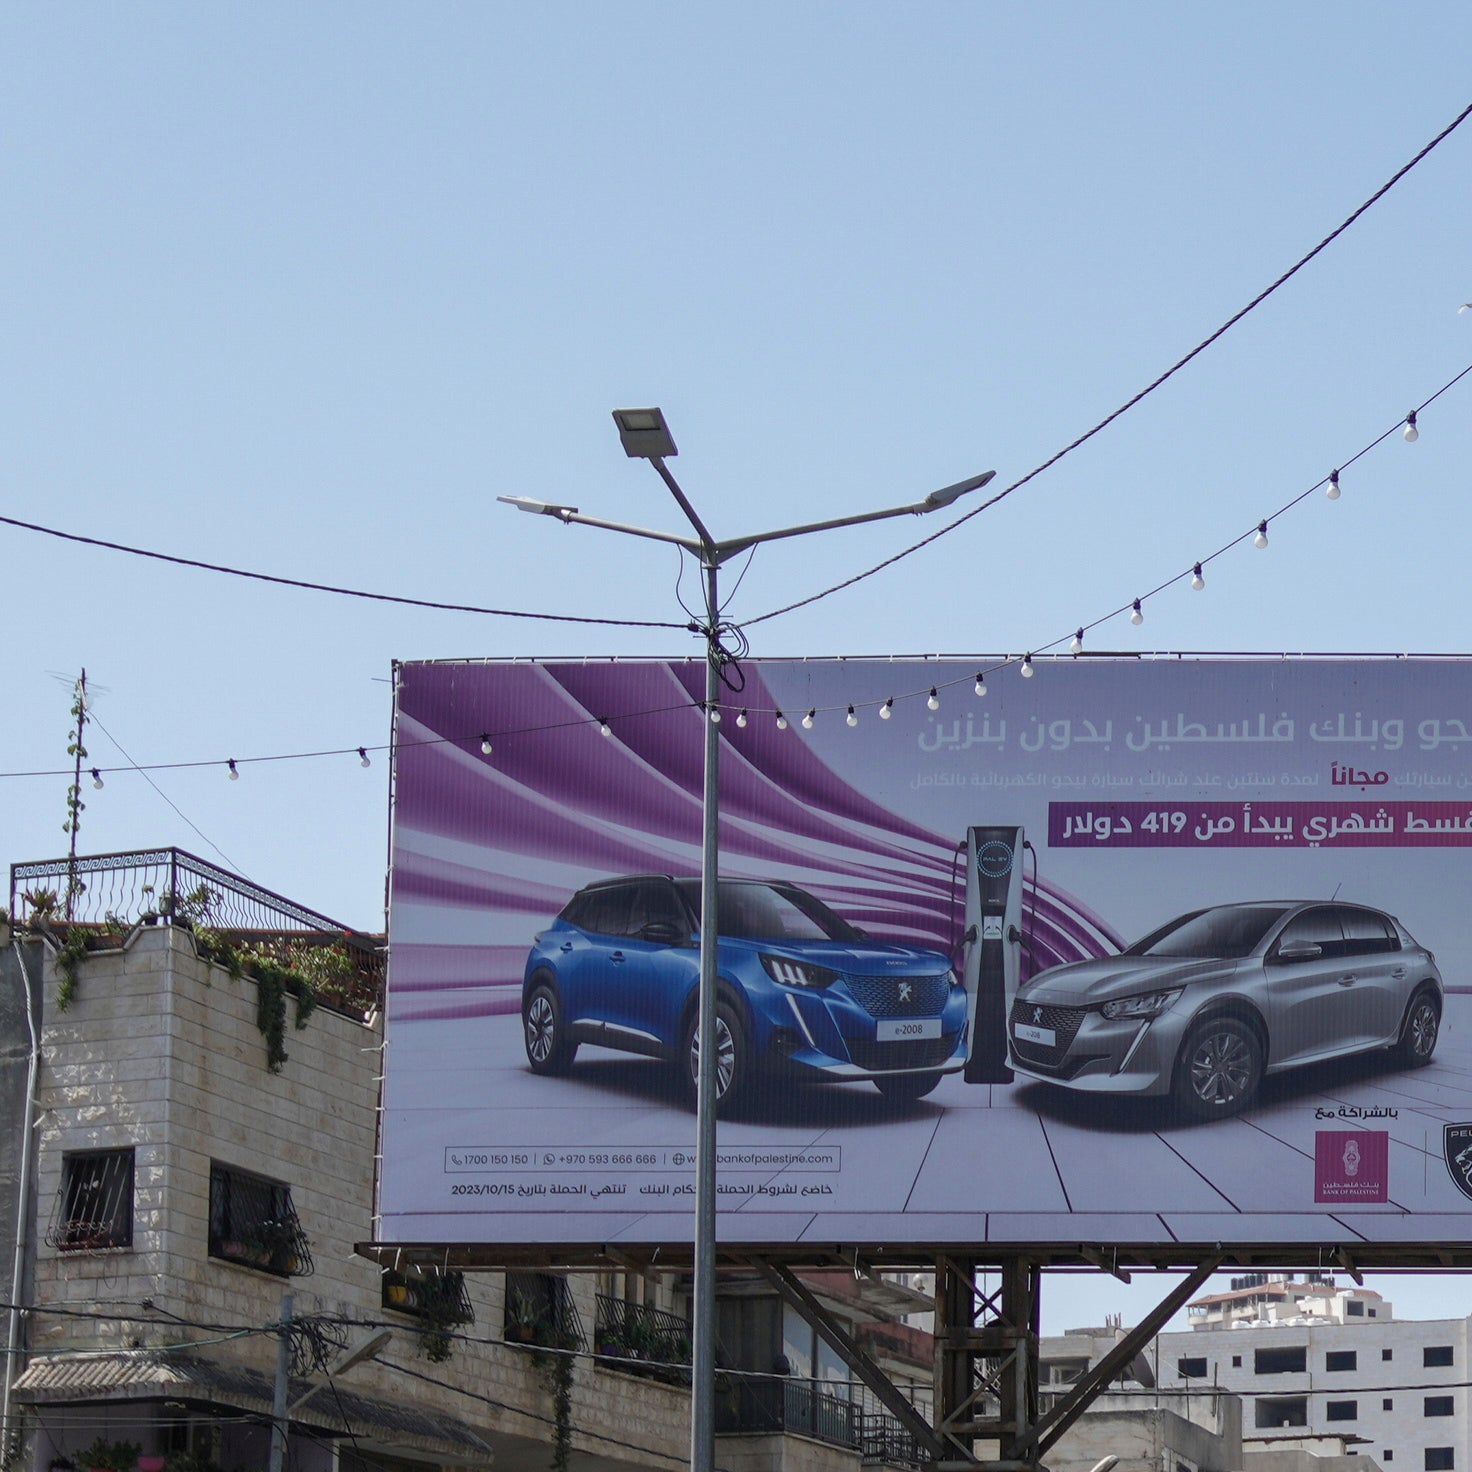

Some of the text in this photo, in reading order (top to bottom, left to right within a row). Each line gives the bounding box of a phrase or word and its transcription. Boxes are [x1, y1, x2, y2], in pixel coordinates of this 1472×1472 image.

[917, 712, 1007, 751] بنزين
[1020, 716, 1113, 751] بدون
[1125, 712, 1295, 751] فلسطين
[1309, 712, 1404, 751] وبنك
[909, 772, 967, 790] بالكامل
[970, 772, 1047, 789] الكهربائية
[1052, 775, 1087, 789] بيجو
[1091, 773, 1134, 789] سيارة
[1190, 773, 1222, 786] عند
[1227, 773, 1276, 790] سنتين
[1281, 772, 1319, 786] لمدة
[1331, 761, 1389, 791] مجاناً
[1395, 771, 1451, 789] سيارتك
[1063, 811, 1133, 840] دولار
[1140, 811, 1187, 834] 419
[1194, 812, 1236, 841] من
[1243, 803, 1294, 841] يبدأ
[1302, 808, 1394, 848] شهري
[1315, 1105, 1399, 1121] بالشراكة مع
[464, 1154, 528, 1165] 1700 150 150
[559, 1154, 657, 1165] +970 593 666 666
[451, 1184, 627, 1200] تنتهي الحملة بتاريخ 2023/10/15
[639, 1184, 669, 1197] البنك
[717, 1184, 754, 1195] الحملة
[757, 1184, 798, 1197] لشروط
[800, 1184, 833, 1197] خاضع
